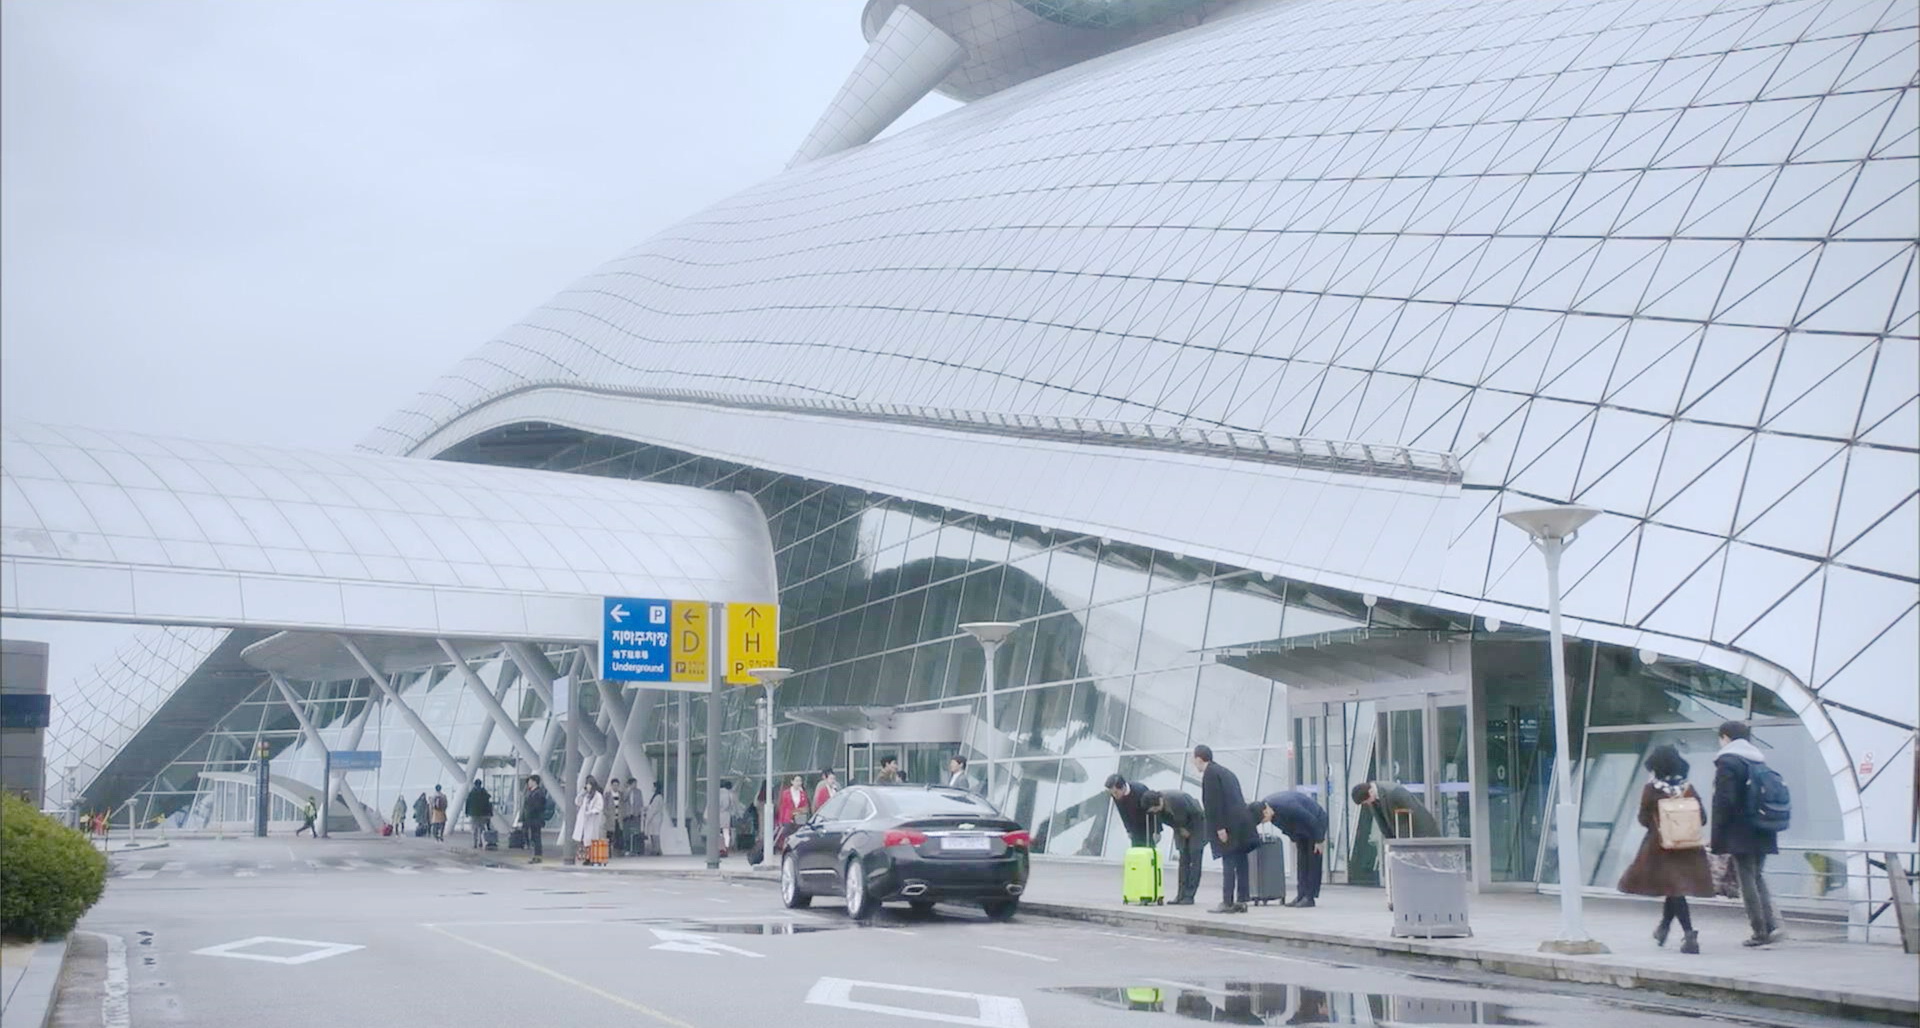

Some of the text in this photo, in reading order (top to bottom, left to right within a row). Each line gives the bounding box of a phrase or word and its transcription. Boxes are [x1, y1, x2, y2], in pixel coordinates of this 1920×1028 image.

[612, 630, 668, 647] 지하주차장
[683, 630, 699, 653] D
[745, 632, 760, 653] H
[612, 661, 664, 674] Underground
[735, 662, 745, 675] P
